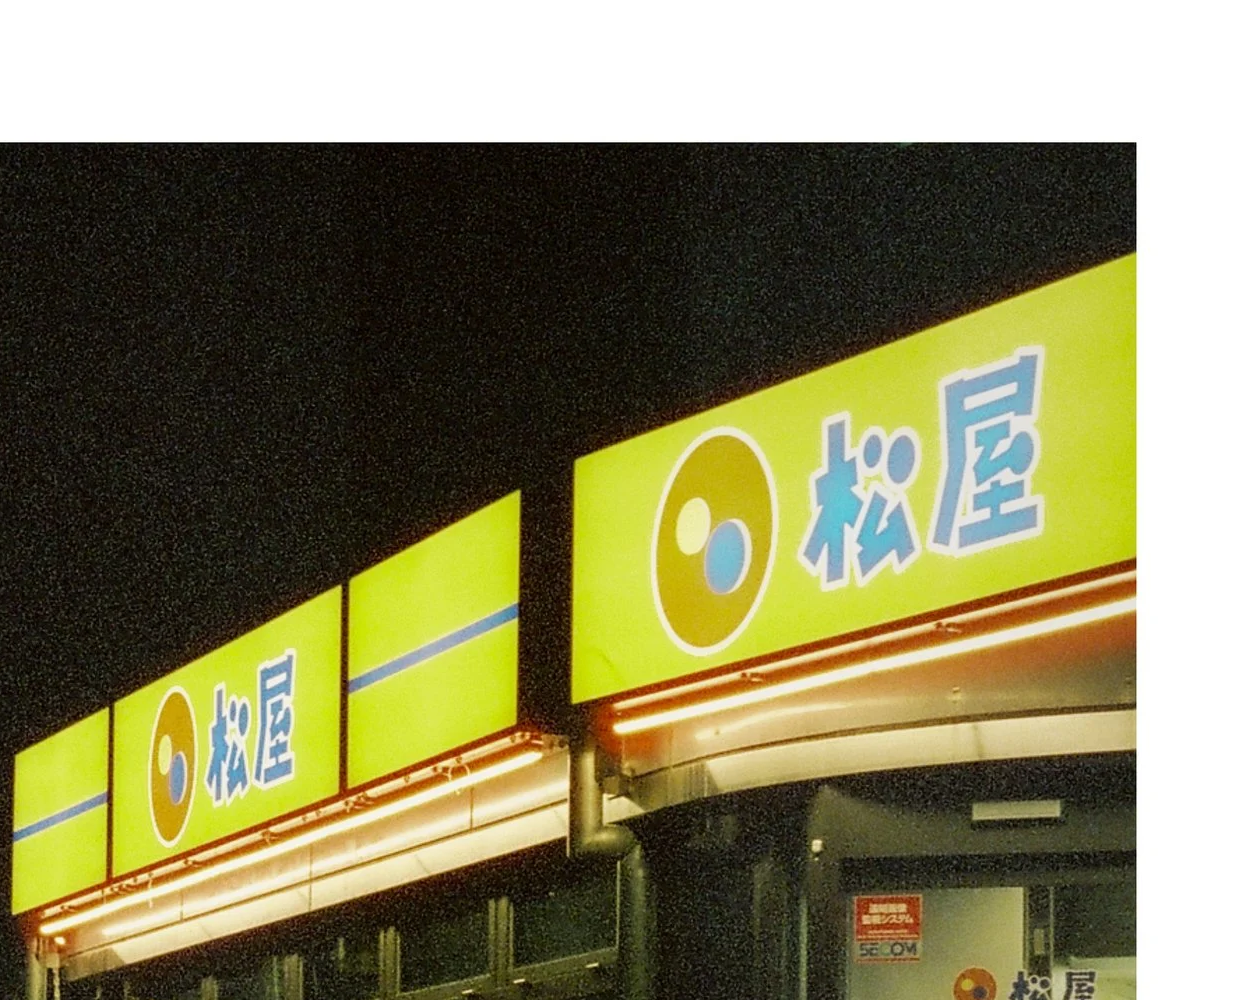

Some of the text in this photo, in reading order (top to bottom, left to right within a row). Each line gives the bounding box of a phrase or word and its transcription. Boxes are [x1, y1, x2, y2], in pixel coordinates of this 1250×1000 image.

[798, 346, 1045, 591] 松屋
[205, 649, 296, 806] 松屋
[860, 942, 917, 956] SECOM
[862, 914, 914, 925] システム
